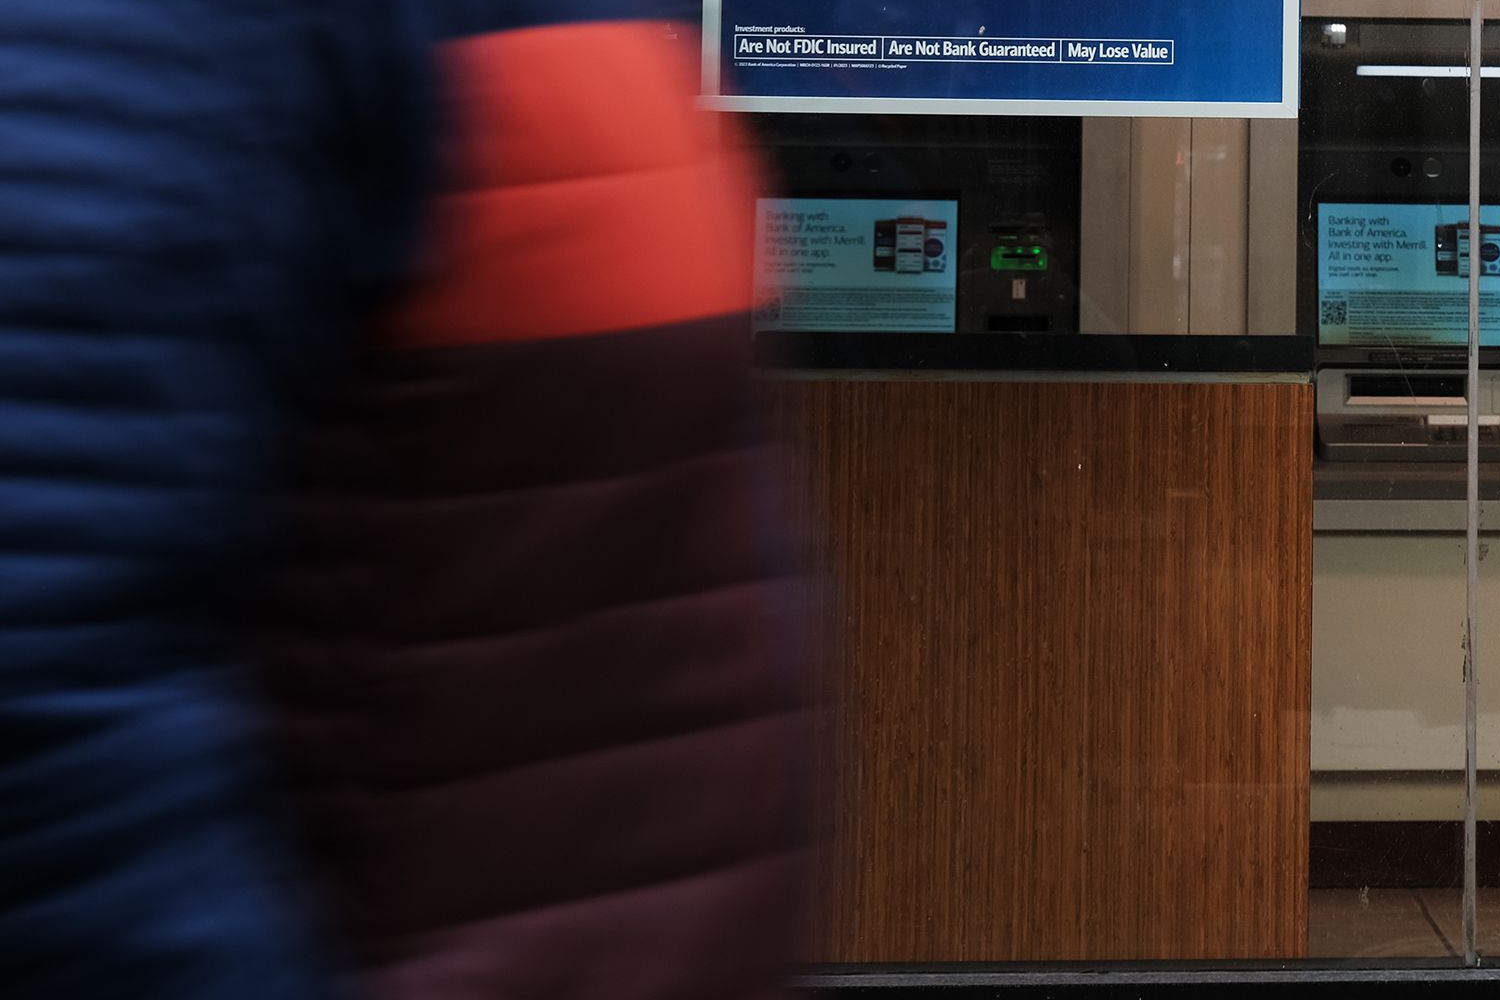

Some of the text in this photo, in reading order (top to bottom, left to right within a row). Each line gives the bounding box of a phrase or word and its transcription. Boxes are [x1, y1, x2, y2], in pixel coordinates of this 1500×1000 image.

[735, 25, 806, 34] Investment products:
[739, 38, 877, 55] Are Not FDIC Insured
[889, 40, 1056, 58] Are Not Bank Guaranteed
[1068, 43, 1169, 62] May Lose Value
[1328, 215, 1390, 227] Banking with
[1328, 227, 1352, 237] Bank
[1354, 227, 1364, 237] of
[1328, 240, 1370, 251] Investing
[1373, 240, 1394, 249] with
[1328, 251, 1340, 261] All
[1343, 251, 1352, 260] in
[1354, 253, 1372, 261] one
